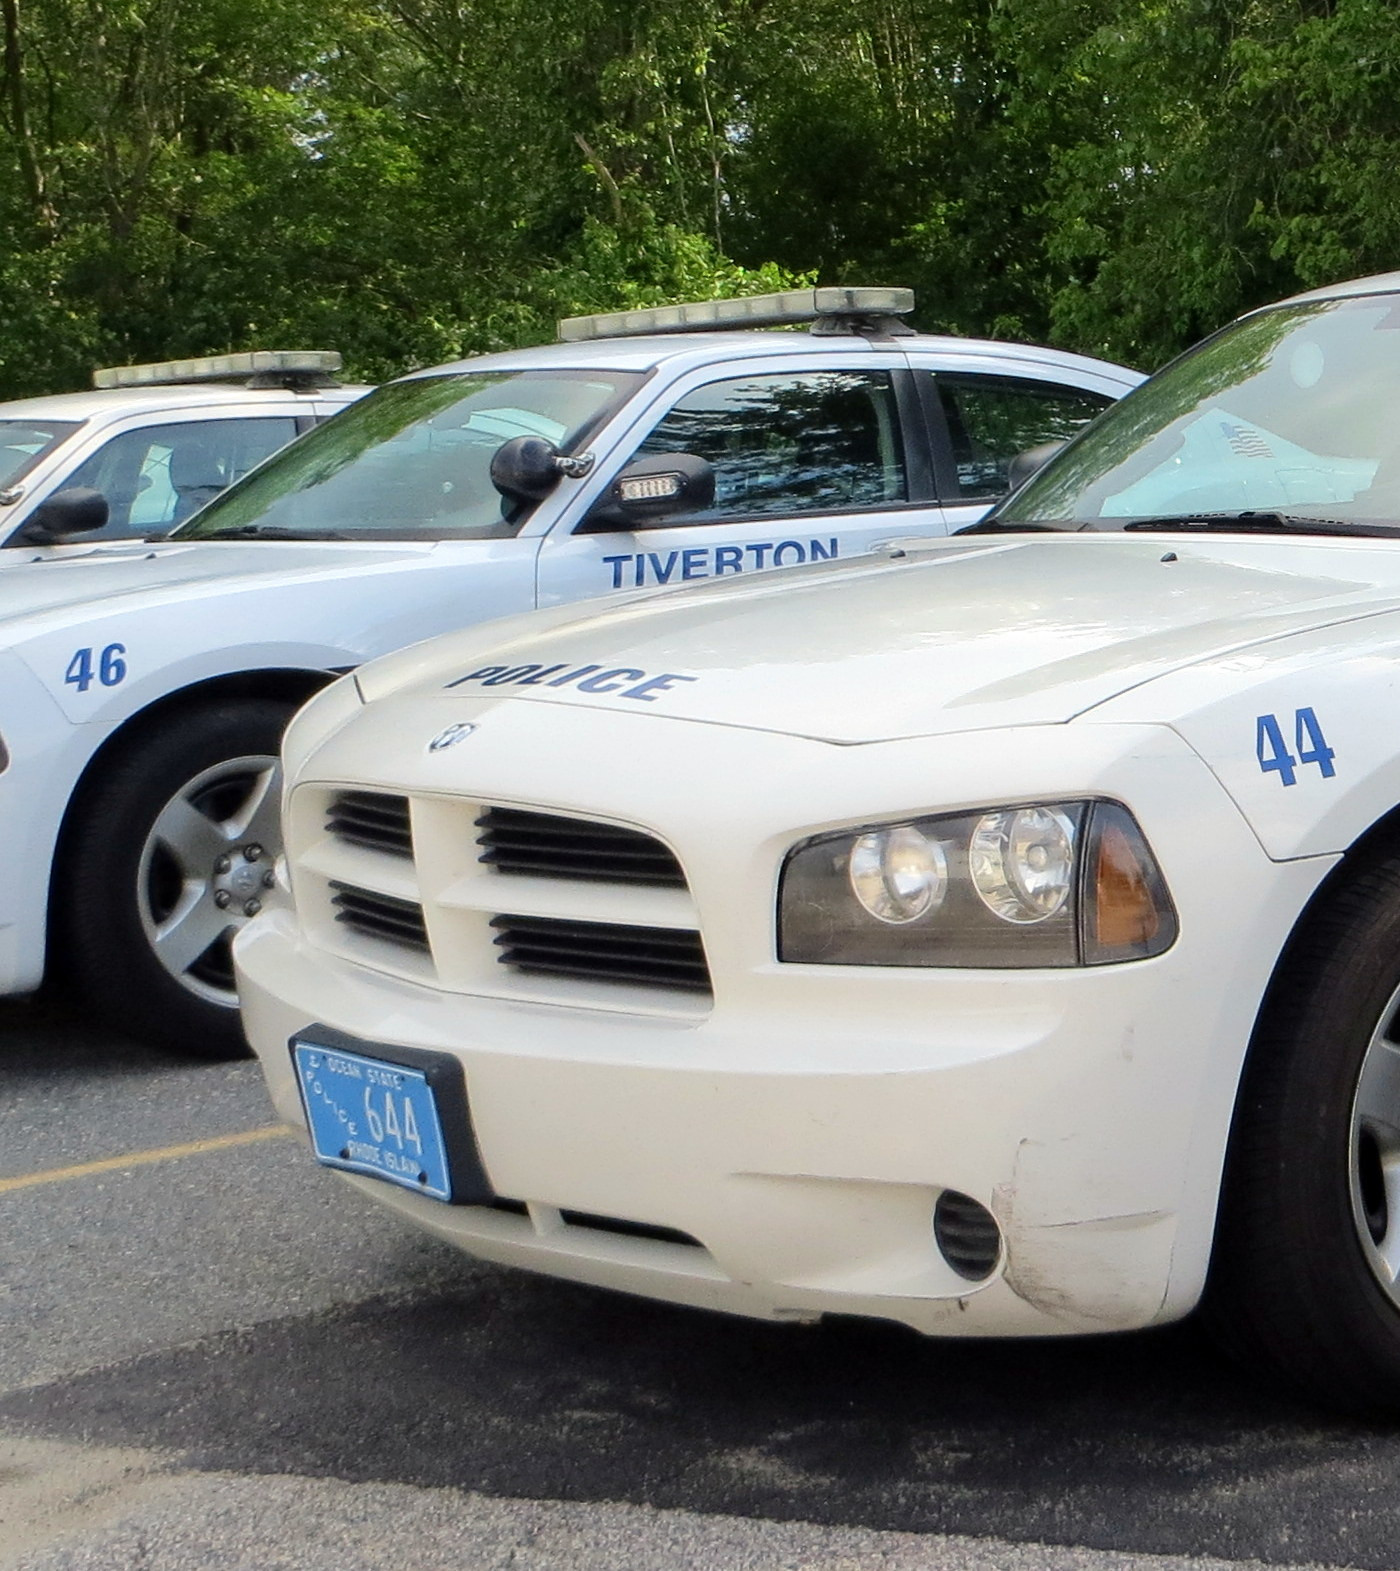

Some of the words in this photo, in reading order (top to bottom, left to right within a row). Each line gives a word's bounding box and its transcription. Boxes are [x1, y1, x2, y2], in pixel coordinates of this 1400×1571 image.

[602, 537, 840, 589] TIVERTON
[64, 642, 127, 693] 46
[442, 663, 700, 702] POLICE
[1256, 706, 1337, 787] 44
[328, 1056, 362, 1080] OCEAN
[367, 1068, 403, 1091] STATE
[305, 1070, 359, 1136] POLICE
[364, 1085, 423, 1157] 644
[346, 1139, 383, 1166] RHODE
